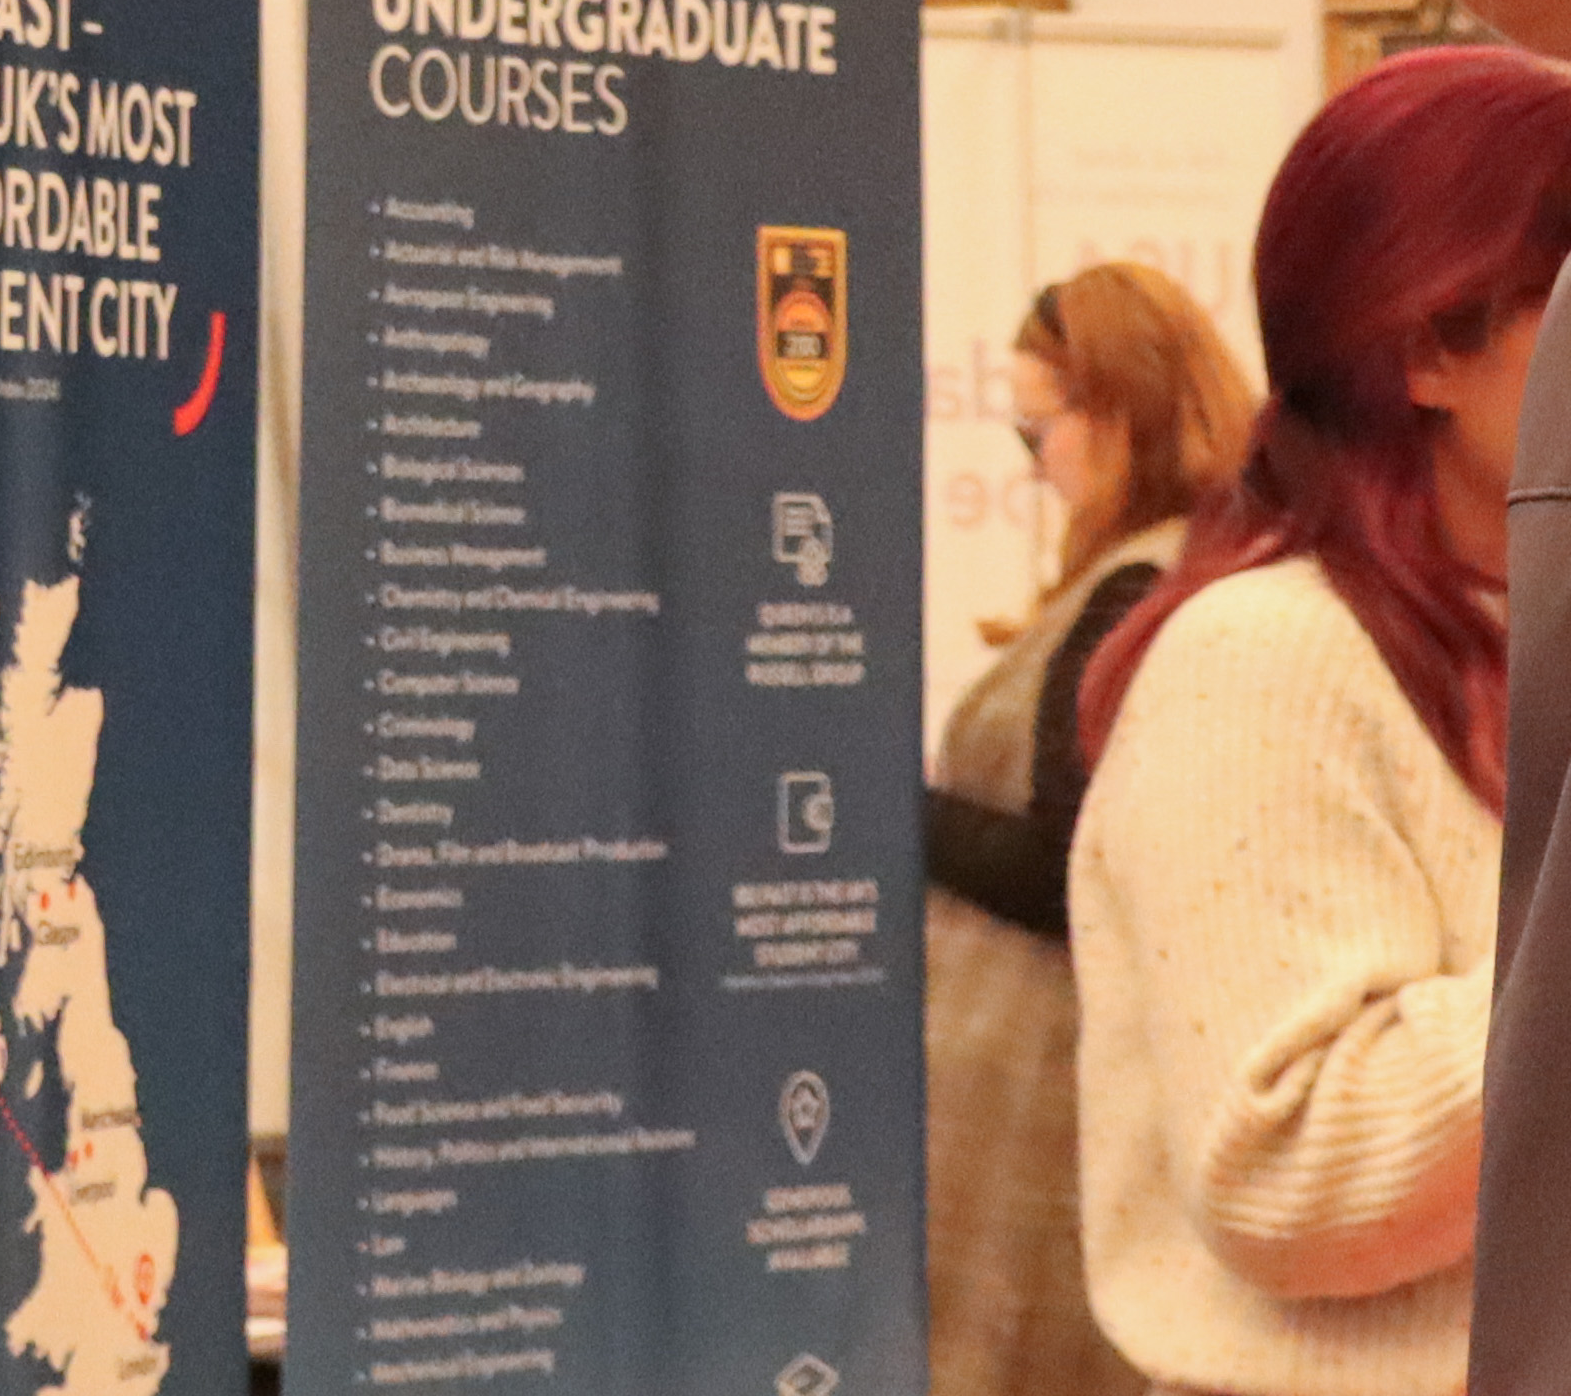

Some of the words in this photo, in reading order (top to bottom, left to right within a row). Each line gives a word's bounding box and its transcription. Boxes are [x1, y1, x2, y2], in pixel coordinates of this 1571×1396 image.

[87, 80, 196, 166] MOST
[370, 44, 627, 135] COURSES
[91, 278, 177, 359] CITY
